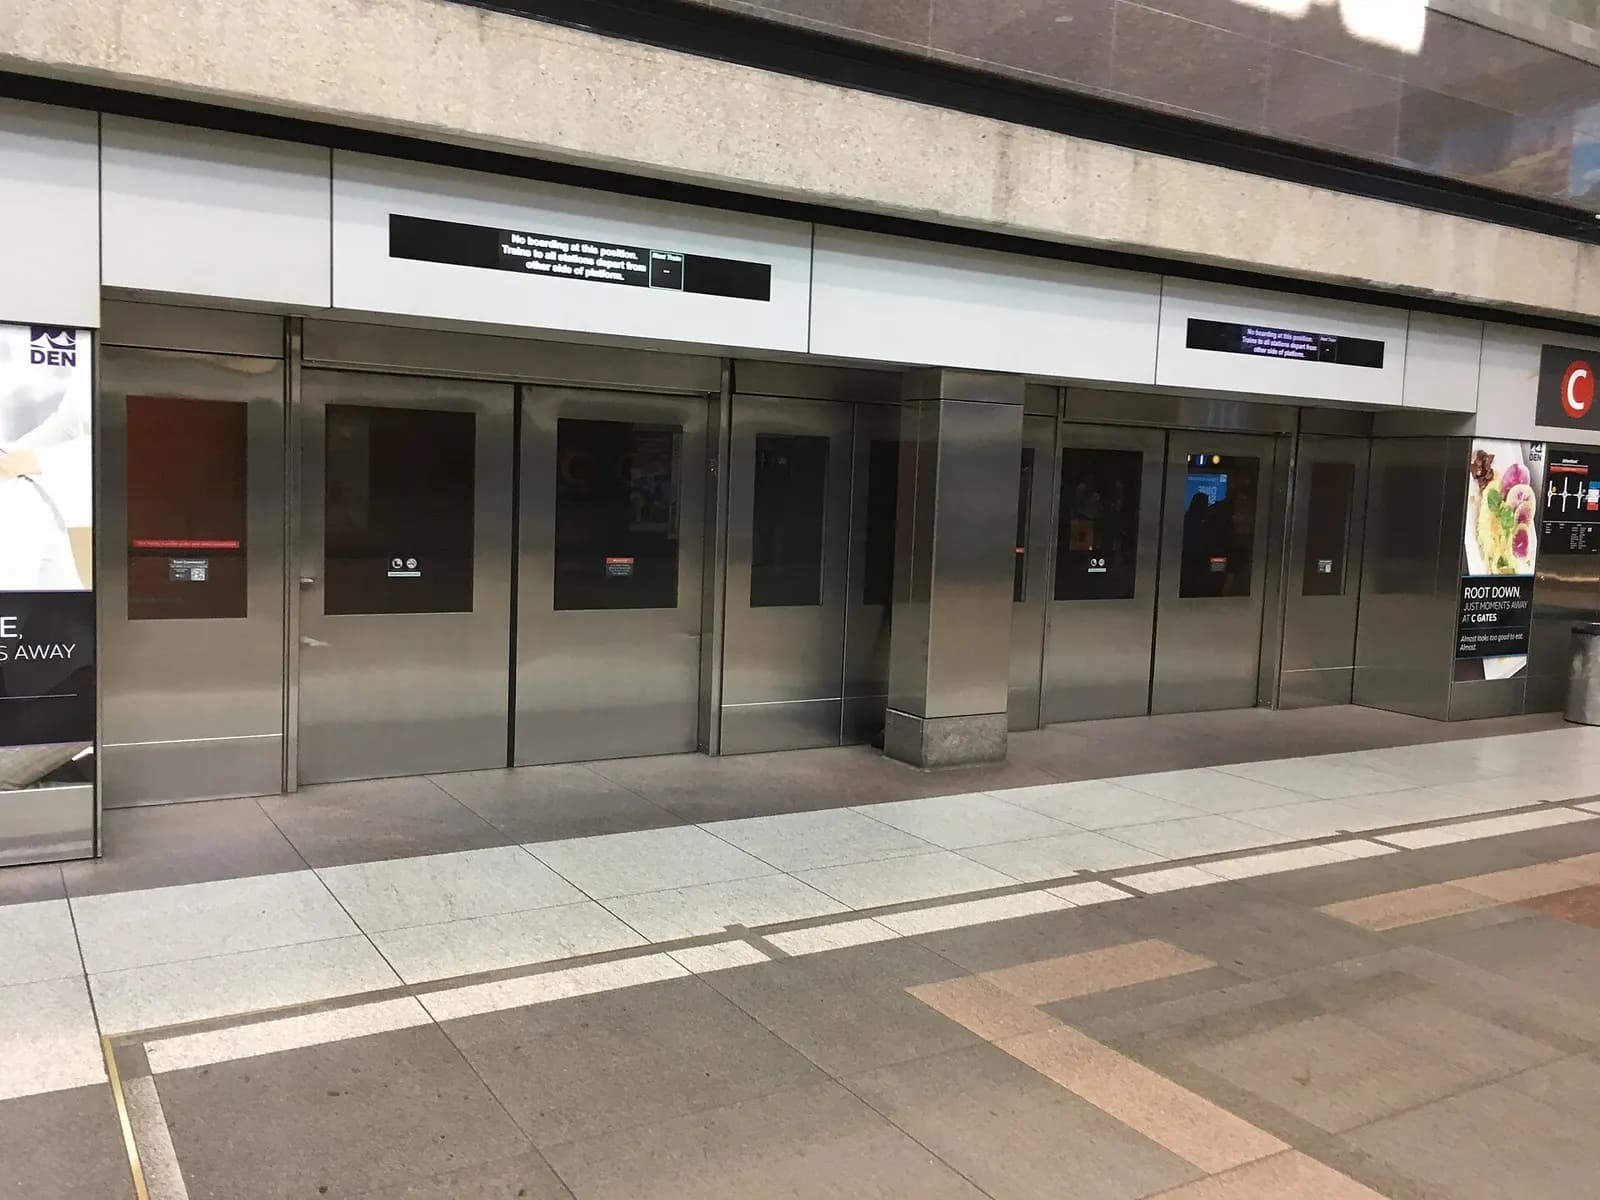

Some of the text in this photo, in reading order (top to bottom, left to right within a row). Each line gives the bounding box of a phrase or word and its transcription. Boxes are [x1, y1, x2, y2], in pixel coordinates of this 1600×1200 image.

[511, 234, 639, 260] No boarding at this position.
[501, 244, 647, 272] Trains to all stations depart from
[525, 261, 625, 280] other side of platform.
[30, 349, 76, 367] DEN
[1567, 369, 1587, 410] C
[1464, 586, 1491, 599] ROOT
[1463, 600, 1529, 611] JUST MOMENTS AWAY
[1462, 613, 1498, 623] AT C GATES
[14, 643, 76, 660] AWAY
